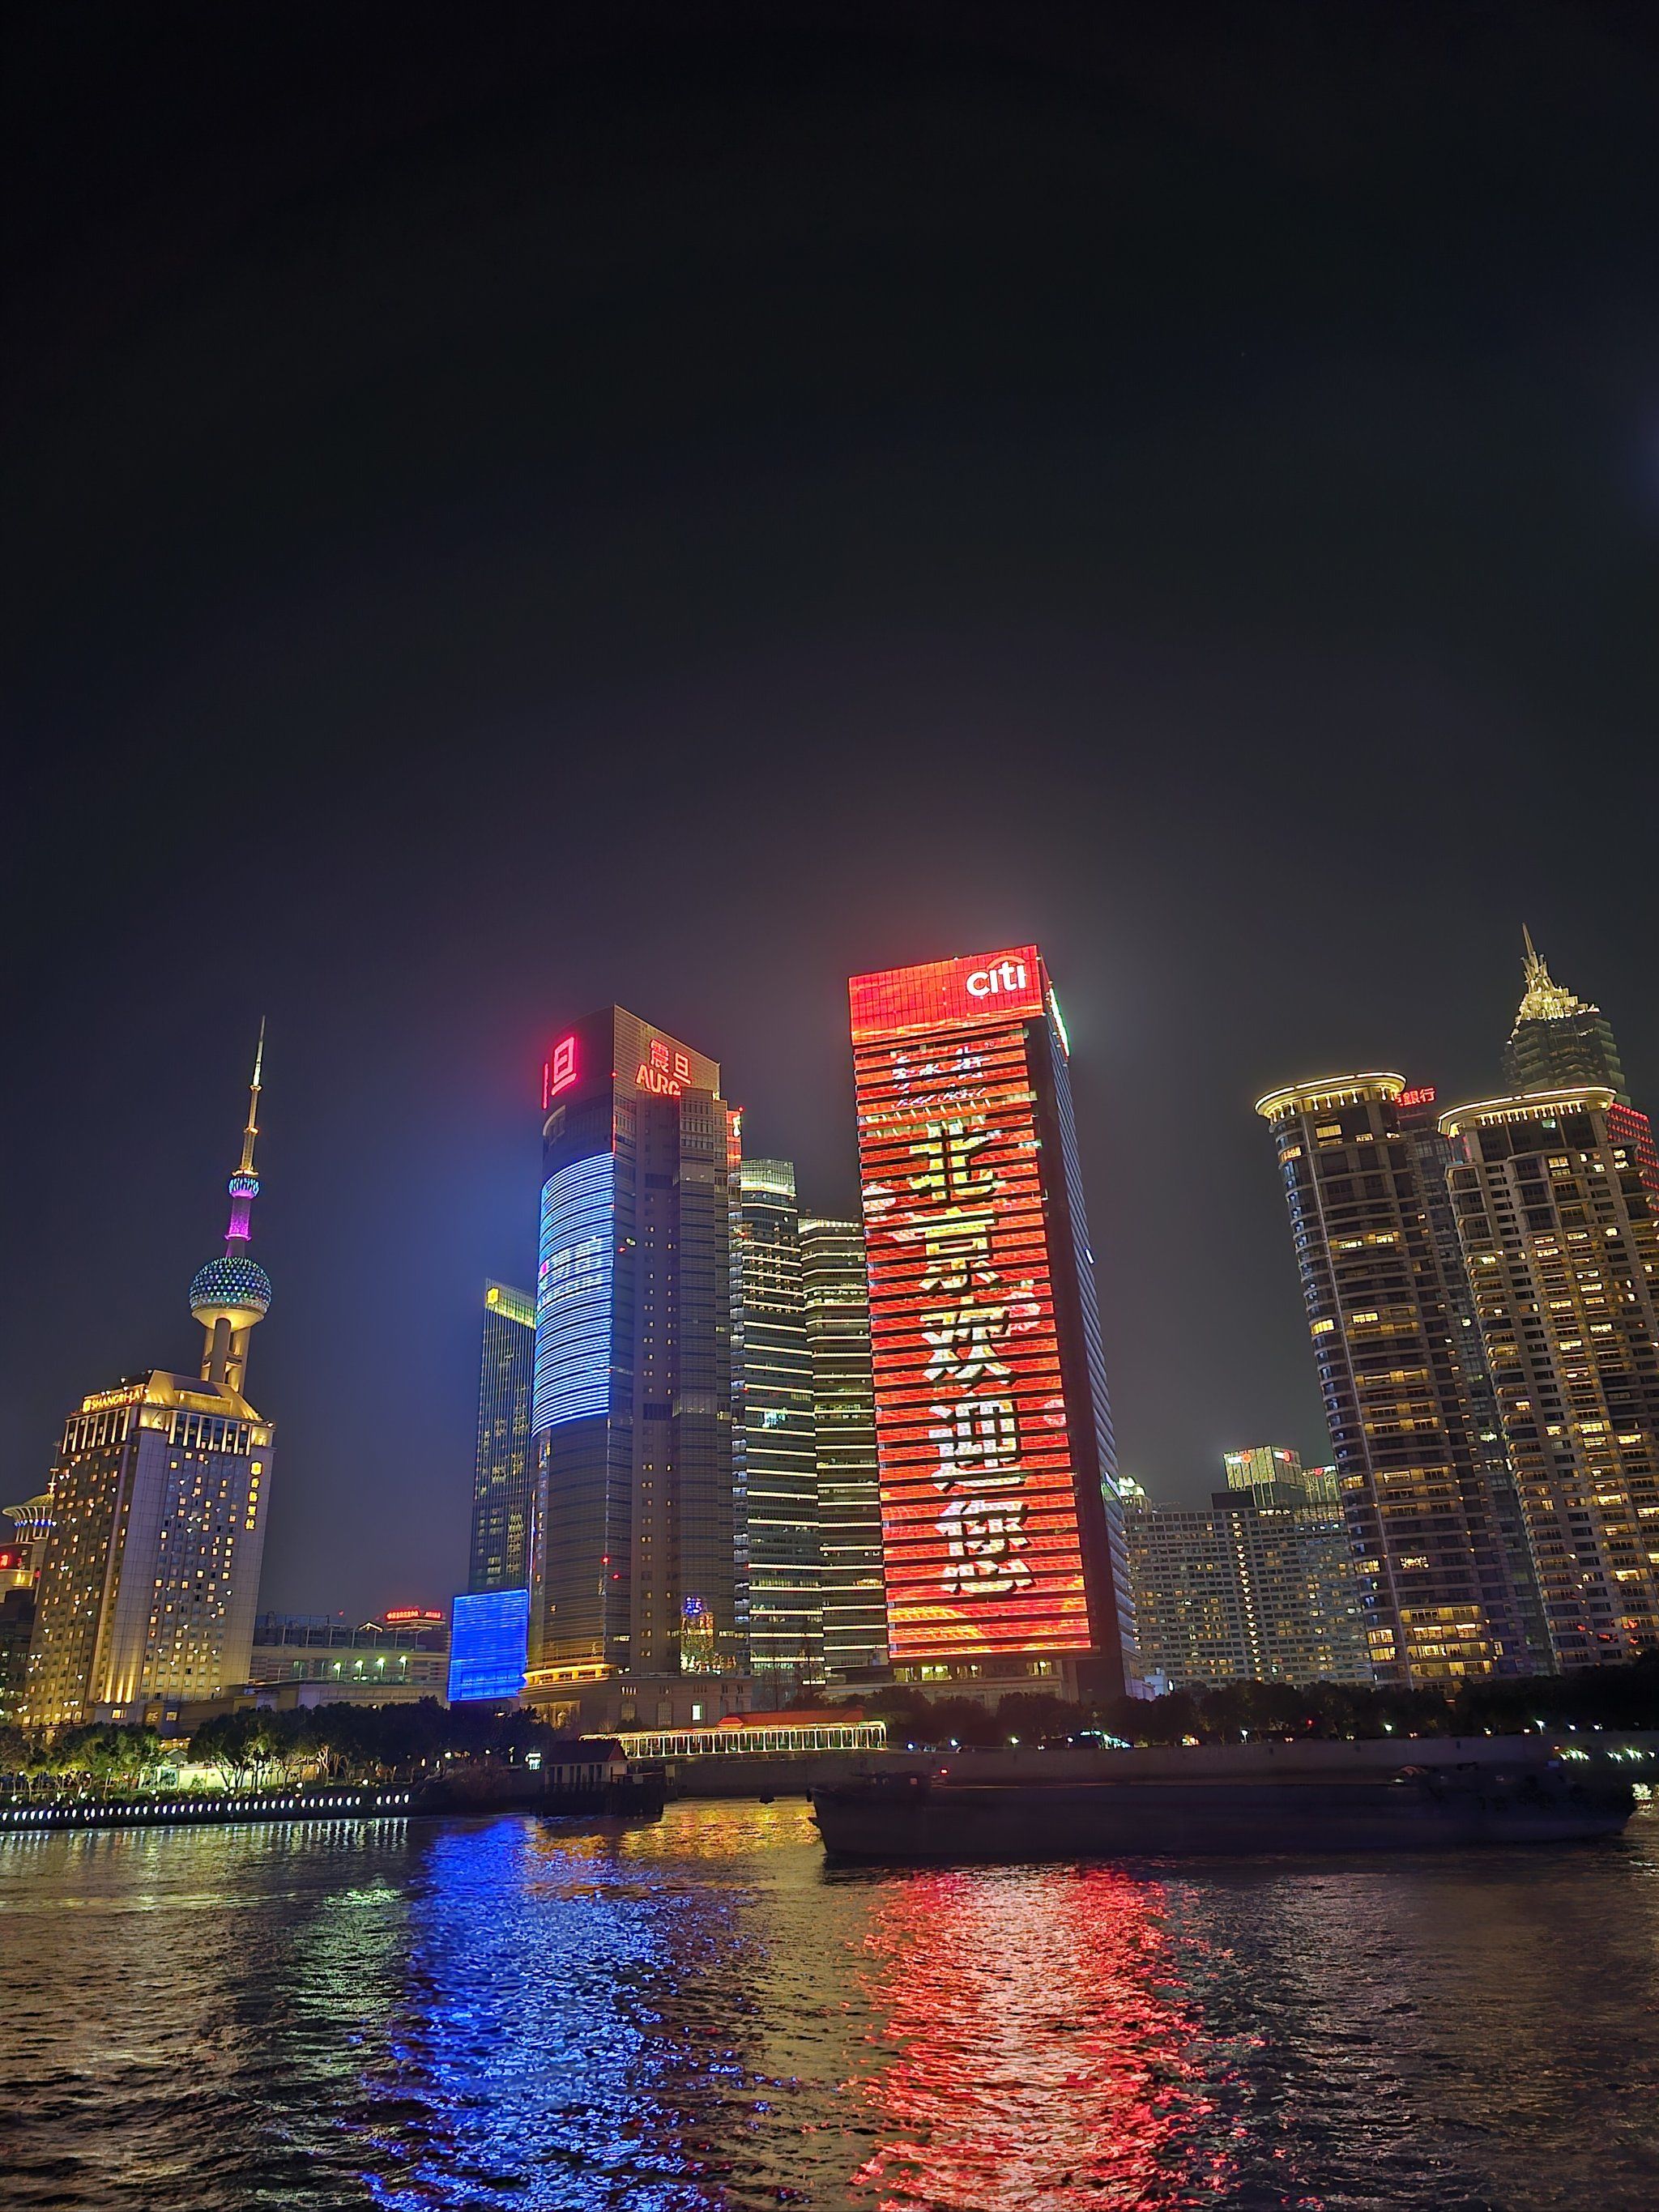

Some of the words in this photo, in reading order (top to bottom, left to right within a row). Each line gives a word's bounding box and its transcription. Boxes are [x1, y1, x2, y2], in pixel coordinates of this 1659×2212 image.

[966, 961, 1026, 997] citi
[650, 1039, 692, 1085] 震旦
[906, 1123, 1034, 1595] 北京欢迎您
